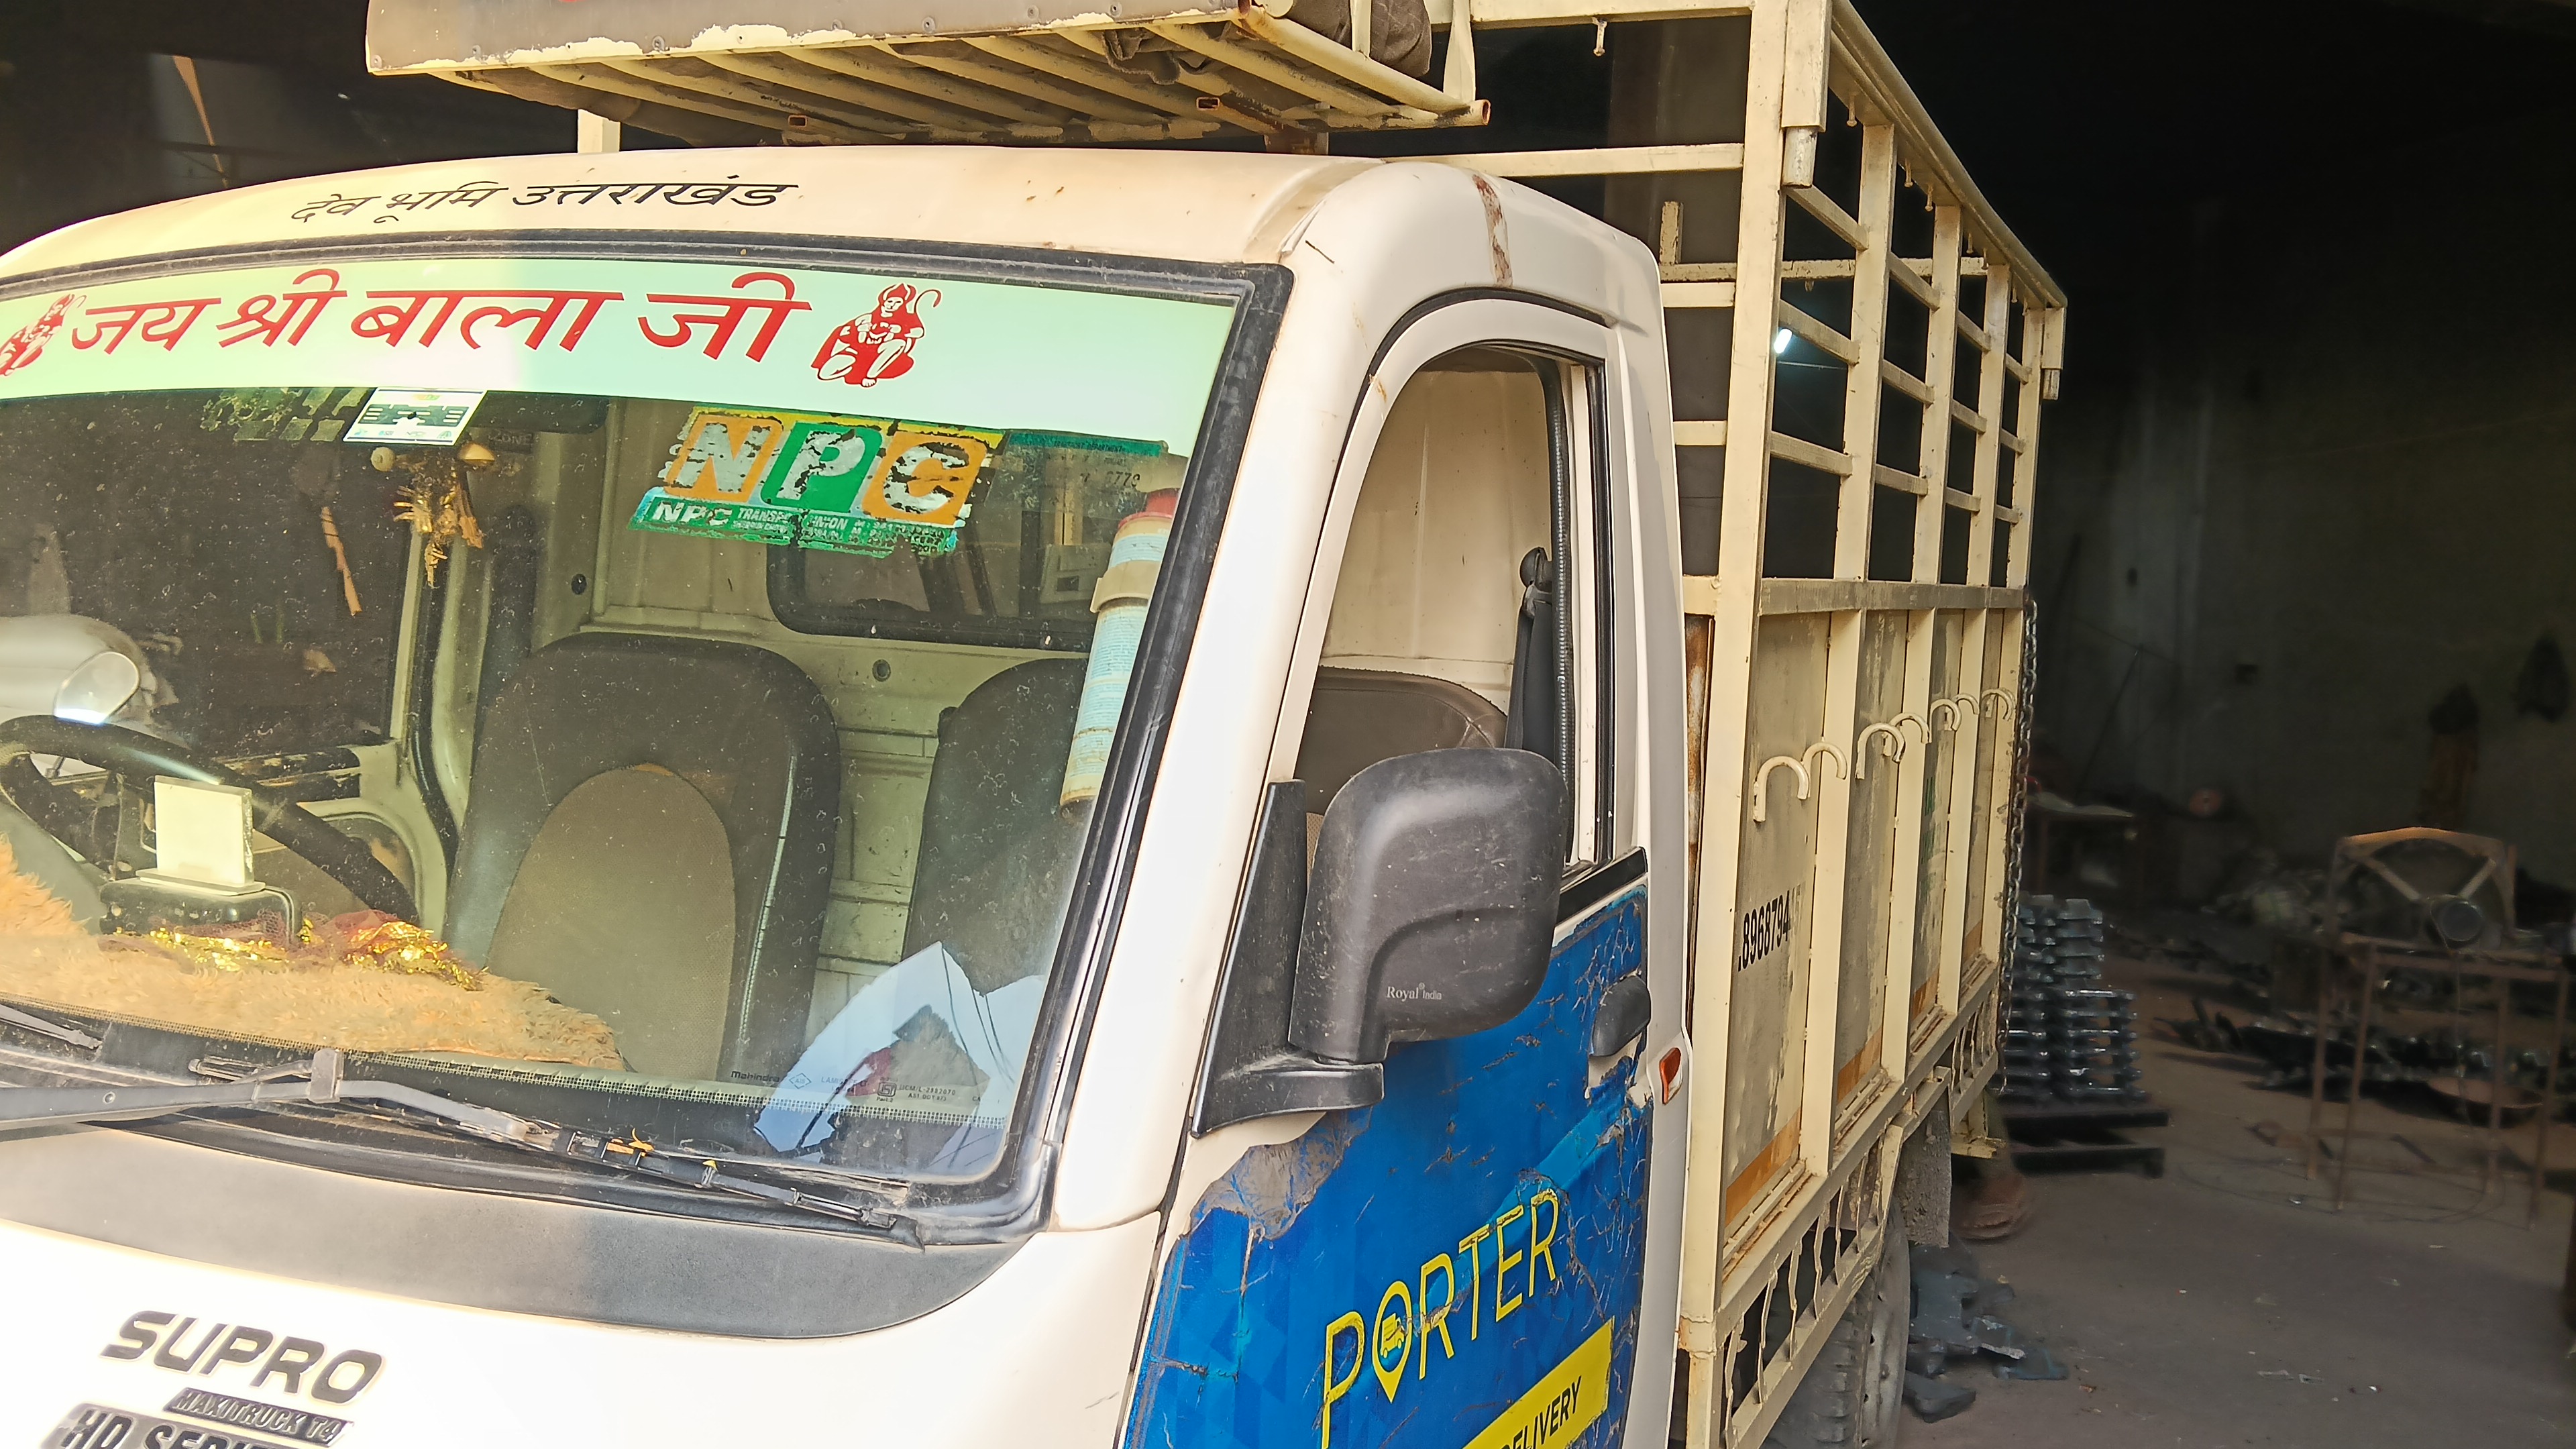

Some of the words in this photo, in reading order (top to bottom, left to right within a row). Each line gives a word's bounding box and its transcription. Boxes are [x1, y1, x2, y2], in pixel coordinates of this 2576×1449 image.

[290, 193, 382, 223] देव
[373, 180, 509, 224] भूमि
[512, 174, 800, 207] उत्तराखंड
[71, 297, 222, 355] जय
[216, 268, 347, 348] श्री
[350, 290, 625, 352] बाला
[637, 271, 812, 363] जी
[672, 422, 970, 514] NPC
[652, 501, 733, 527] NPC
[1386, 985, 1419, 1002] Royal
[1422, 989, 1442, 1000] India
[1321, 1187, 1560, 1449] PORTER
[98, 1309, 388, 1406] SUPRO
[172, 1389, 307, 1434] MAXITRUCK
[1500, 1375, 1582, 1449] ELIVERY
